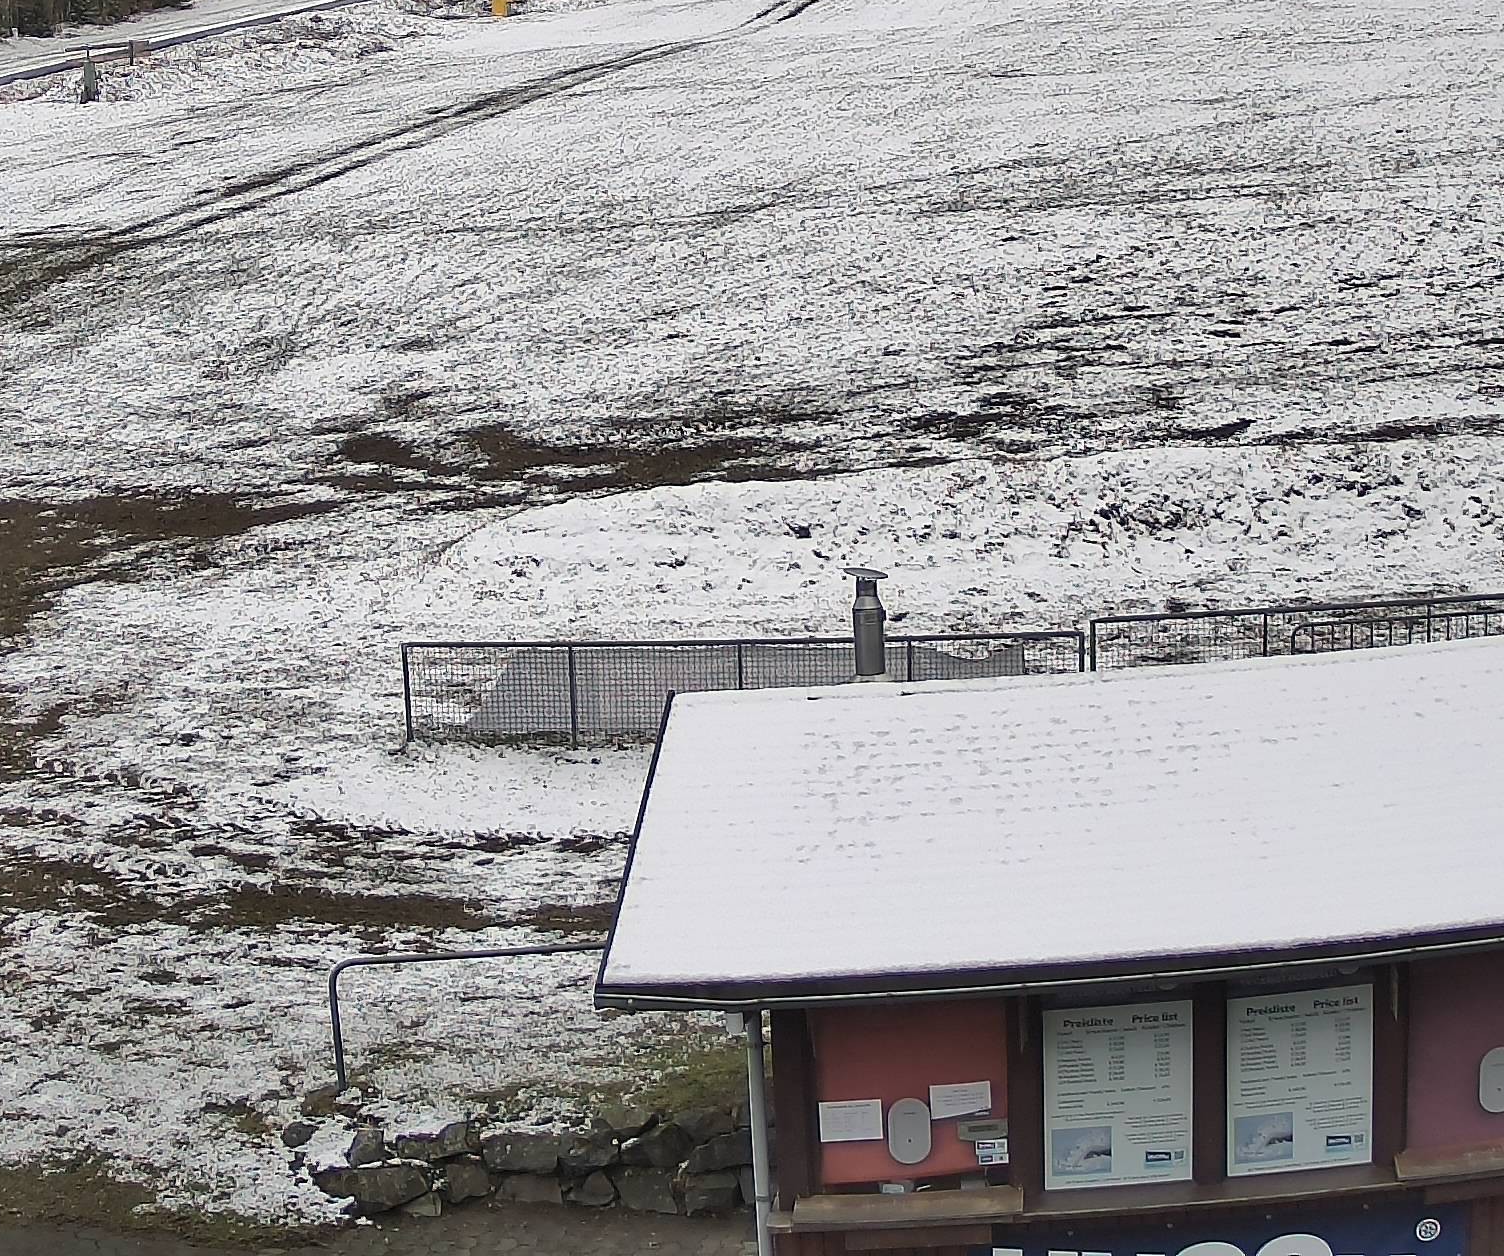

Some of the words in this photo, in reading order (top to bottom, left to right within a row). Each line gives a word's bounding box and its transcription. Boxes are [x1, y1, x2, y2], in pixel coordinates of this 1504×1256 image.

[1313, 998, 1340, 1009] Price
[1342, 996, 1359, 1006] list
[1132, 1013, 1160, 1024] Price
[1161, 1011, 1178, 1022] list
